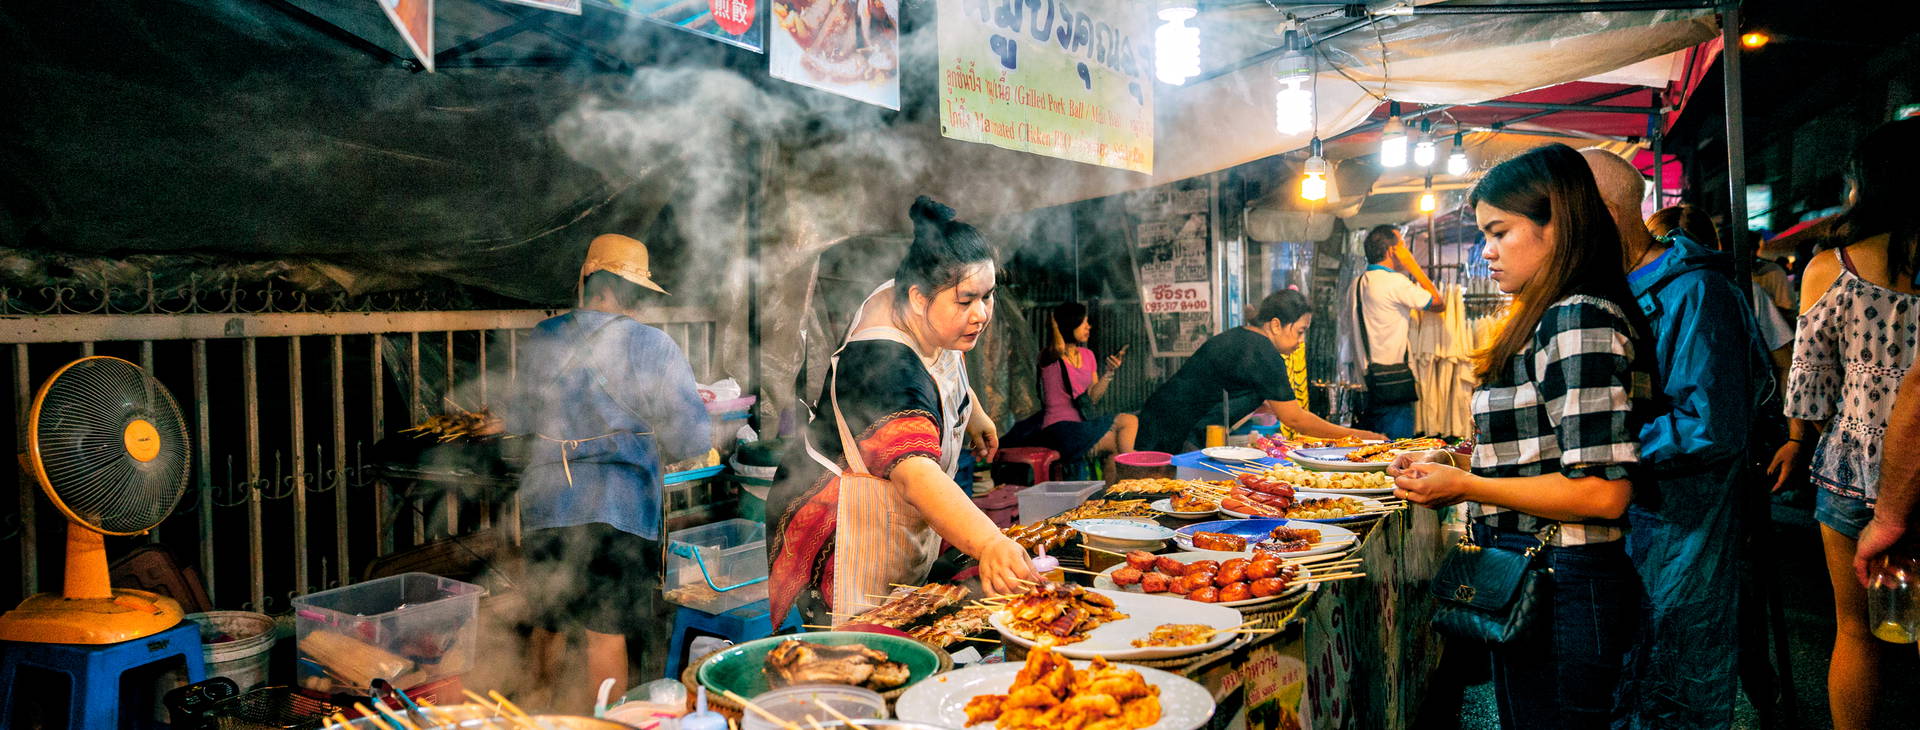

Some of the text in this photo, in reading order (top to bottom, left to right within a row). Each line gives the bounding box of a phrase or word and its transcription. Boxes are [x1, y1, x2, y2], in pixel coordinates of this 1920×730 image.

[1047, 94, 1066, 115] Pork
[1069, 99, 1085, 119] Ball
[1152, 284, 1197, 300] ซื้อรถ
[1180, 299, 1207, 310] 8400
